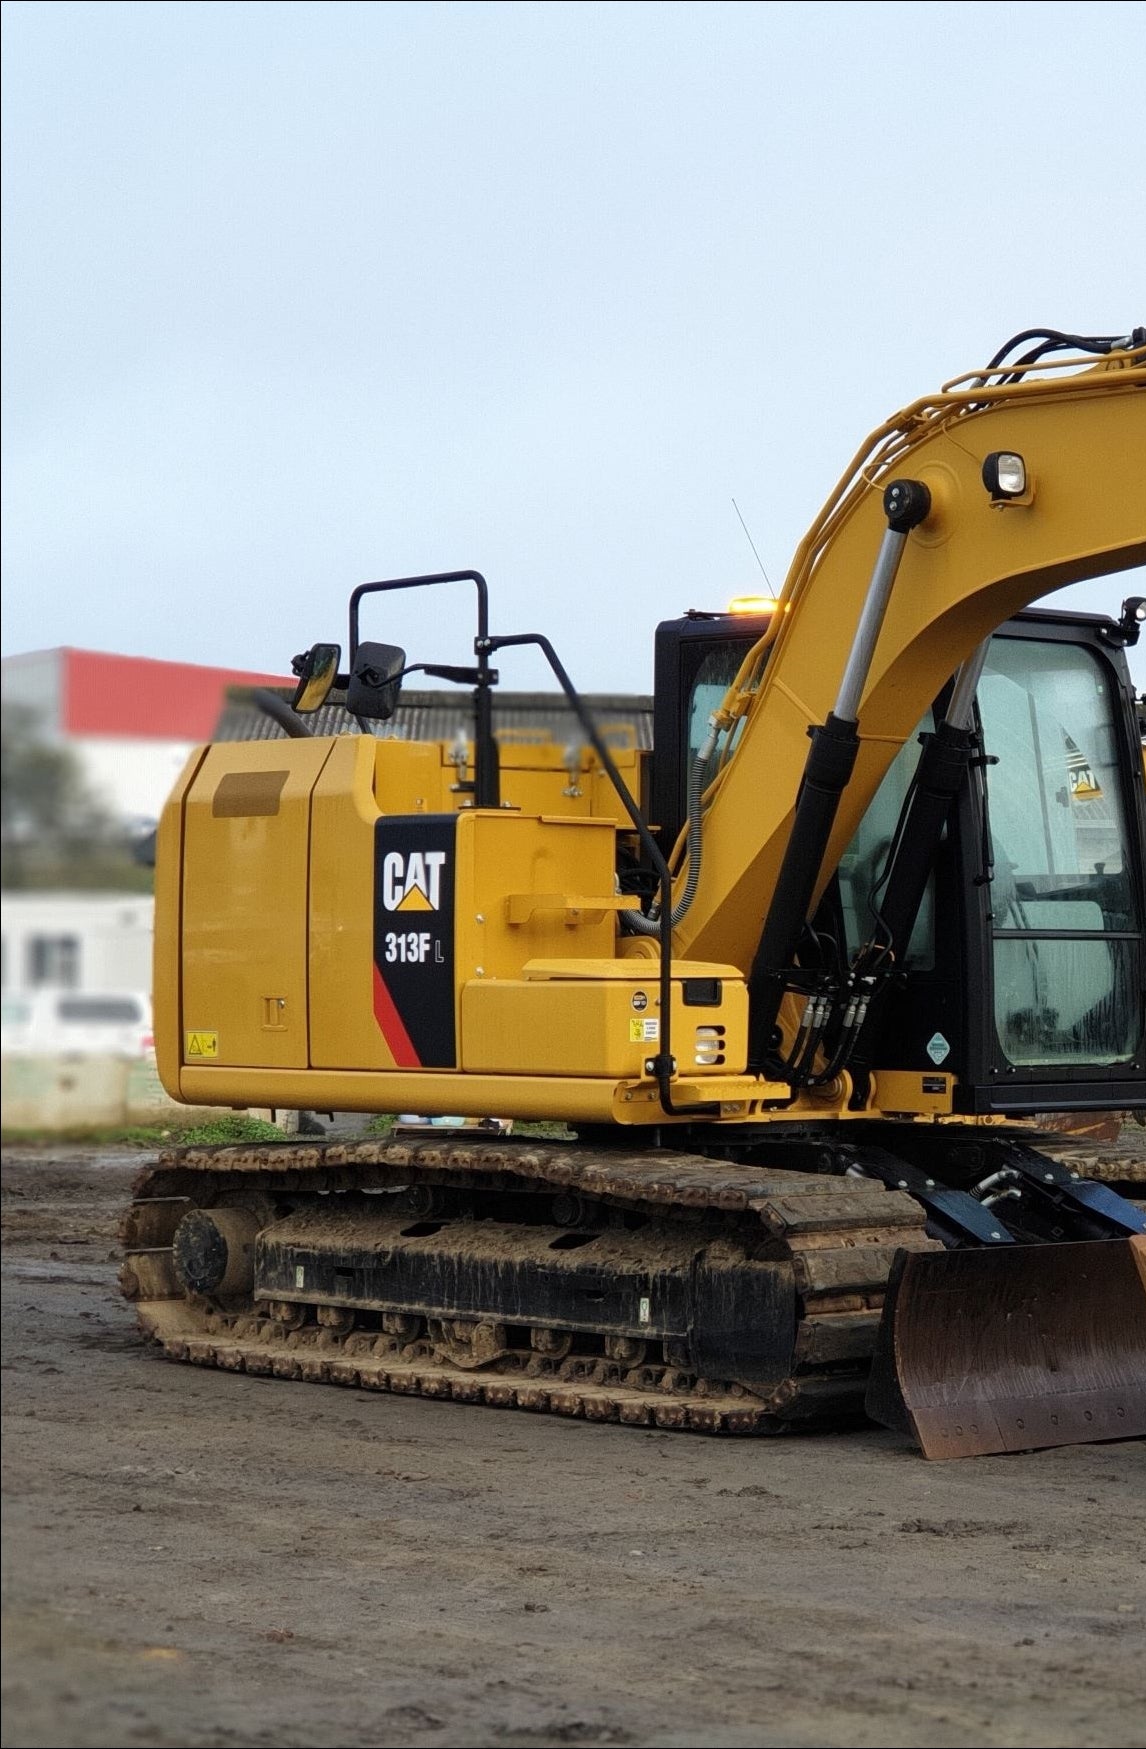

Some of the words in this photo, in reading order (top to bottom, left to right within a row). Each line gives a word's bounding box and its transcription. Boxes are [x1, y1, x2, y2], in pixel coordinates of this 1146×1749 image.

[1069, 770, 1097, 792] CAT
[383, 851, 446, 911] CAT
[385, 932, 431, 962] 313F
[435, 940, 445, 963] L
